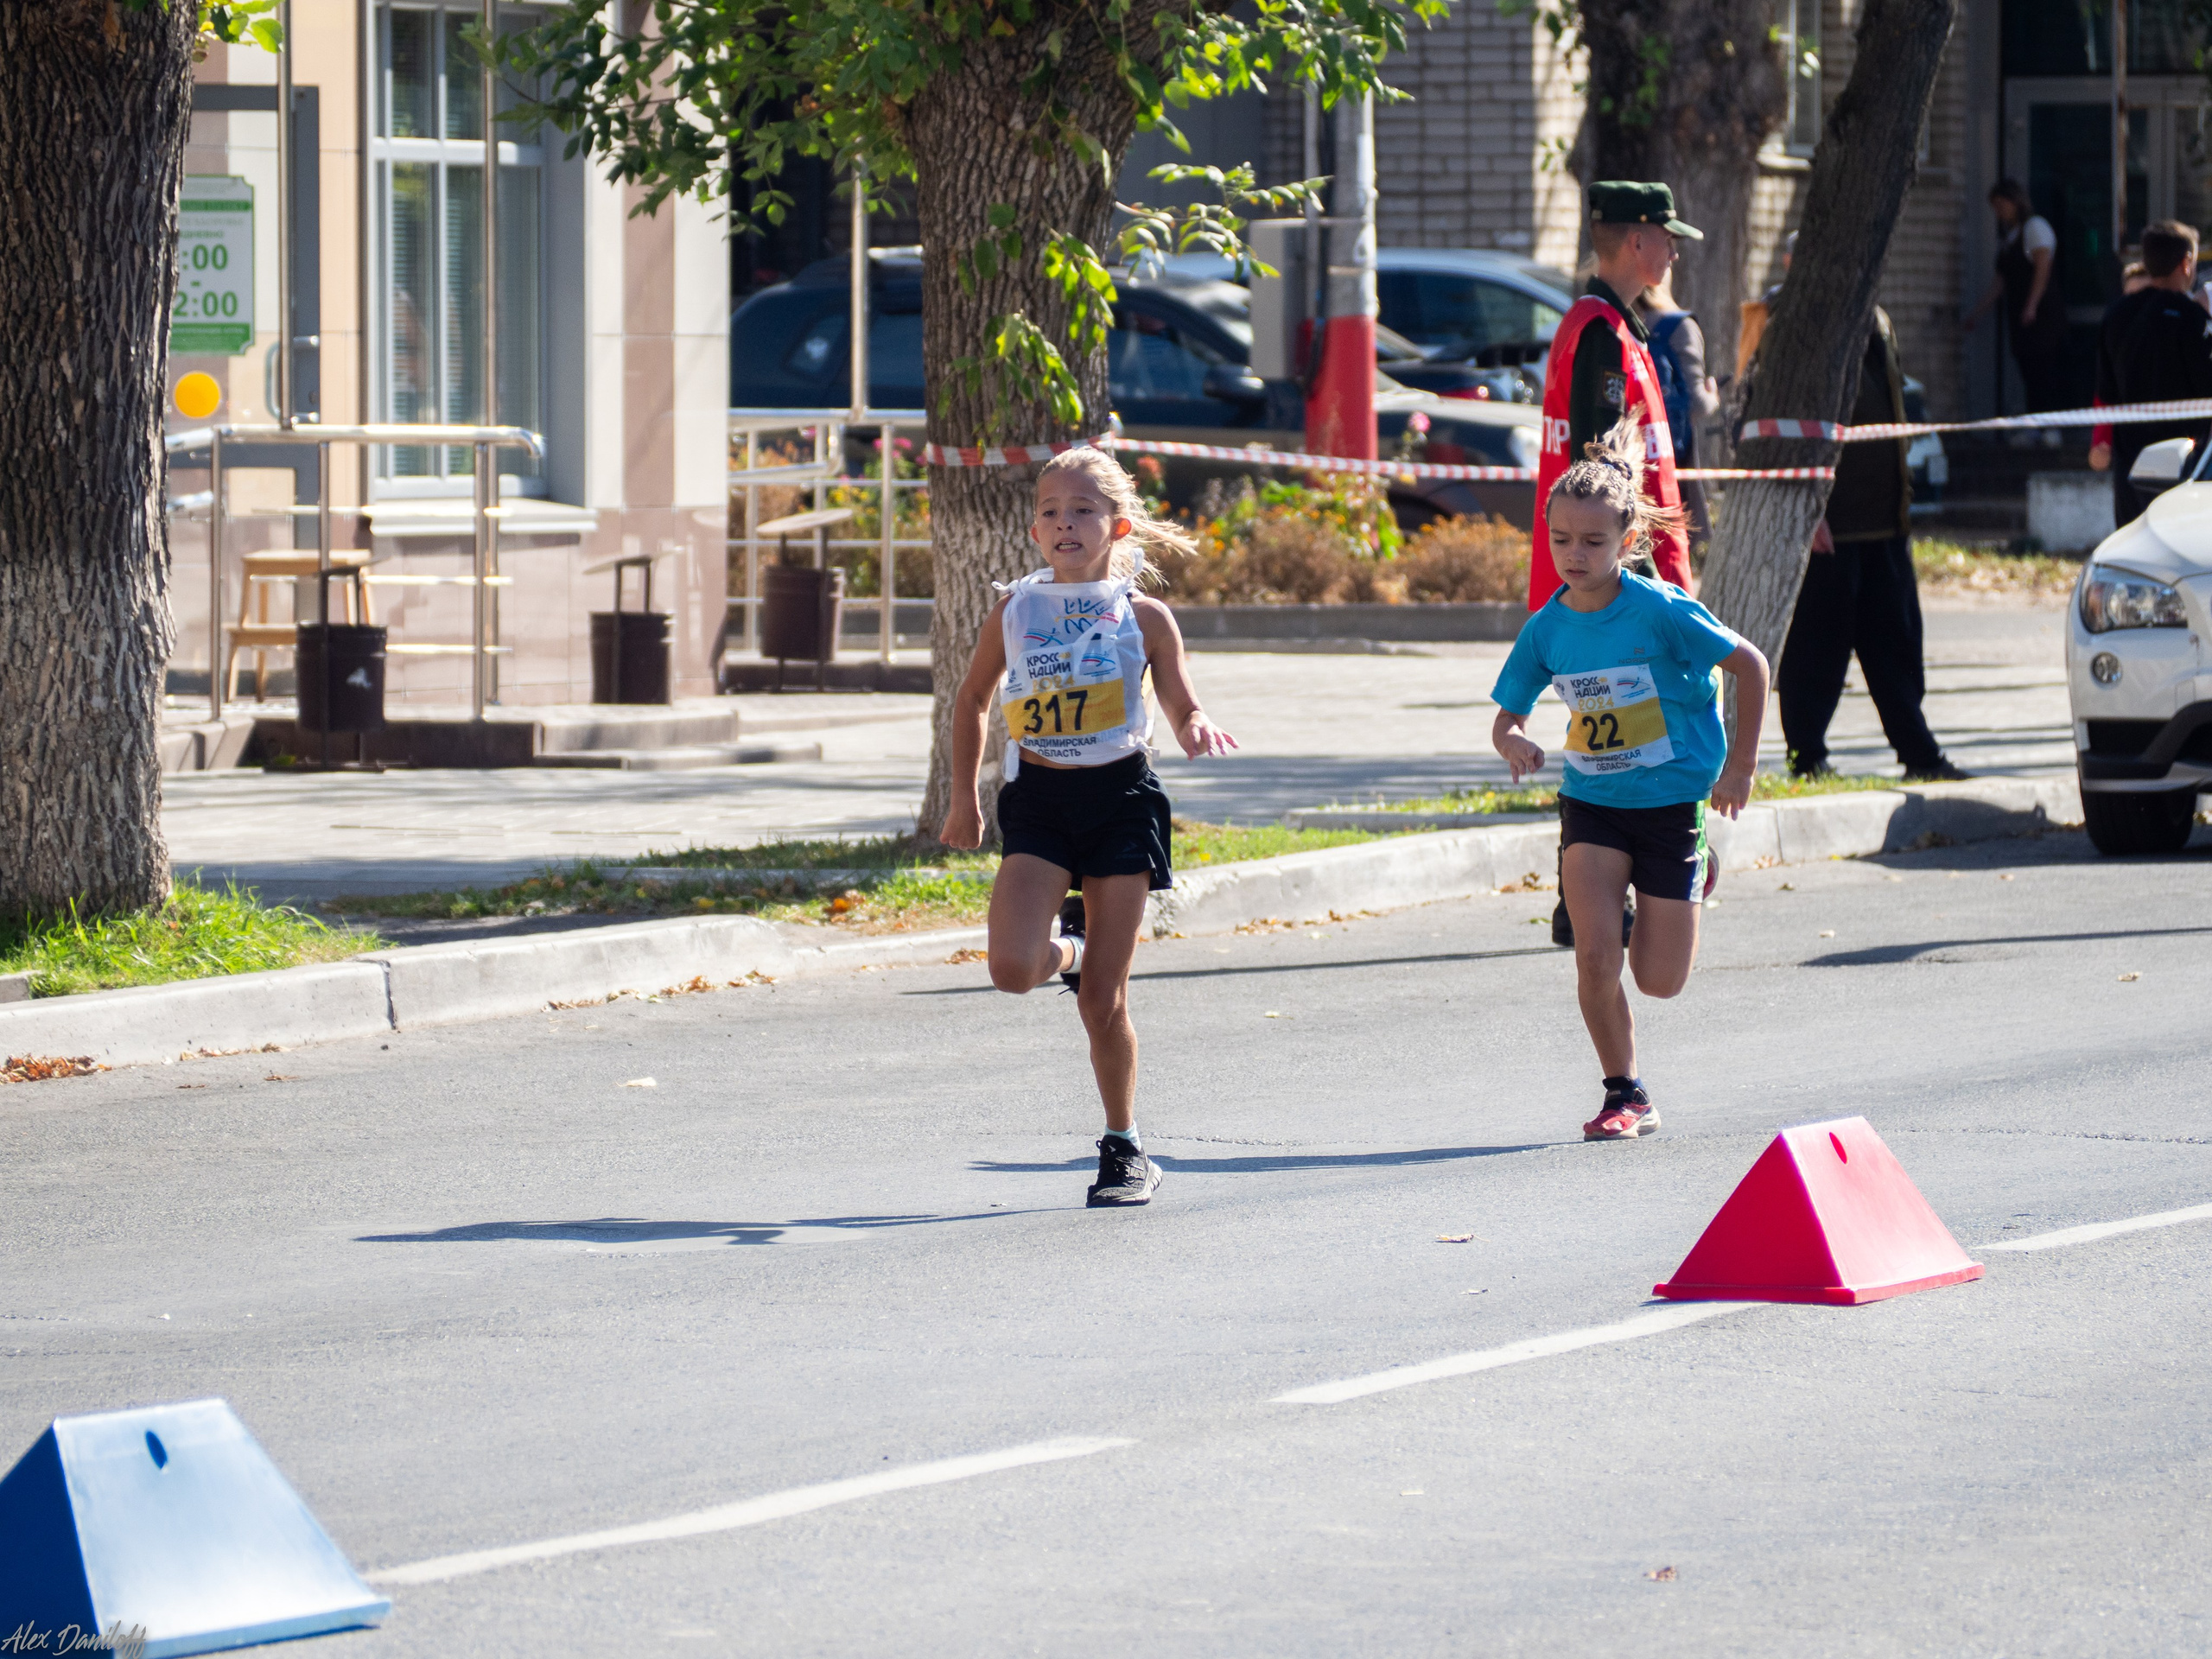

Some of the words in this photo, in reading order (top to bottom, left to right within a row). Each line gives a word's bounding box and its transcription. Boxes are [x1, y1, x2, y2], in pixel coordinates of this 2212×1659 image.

[1026, 652, 1059, 667] КРОСС
[1028, 661, 1071, 679] НАЦИИ
[1032, 676, 1076, 693] 2024
[1570, 676, 1599, 689] КРОСС
[1573, 685, 1611, 699] НАЦИИ
[1577, 696, 1615, 711] 2024
[1023, 690, 1089, 734] 317
[1581, 713, 1624, 751] 22
[1023, 736, 1097, 749] ВЛАДИМИРСКАЯ
[1038, 747, 1082, 758] ОБЛАСТЬ
[1581, 749, 1642, 763] ВЛАДИМИРСКАЯ
[1596, 761, 1631, 772] ОБЛАСТЬ
